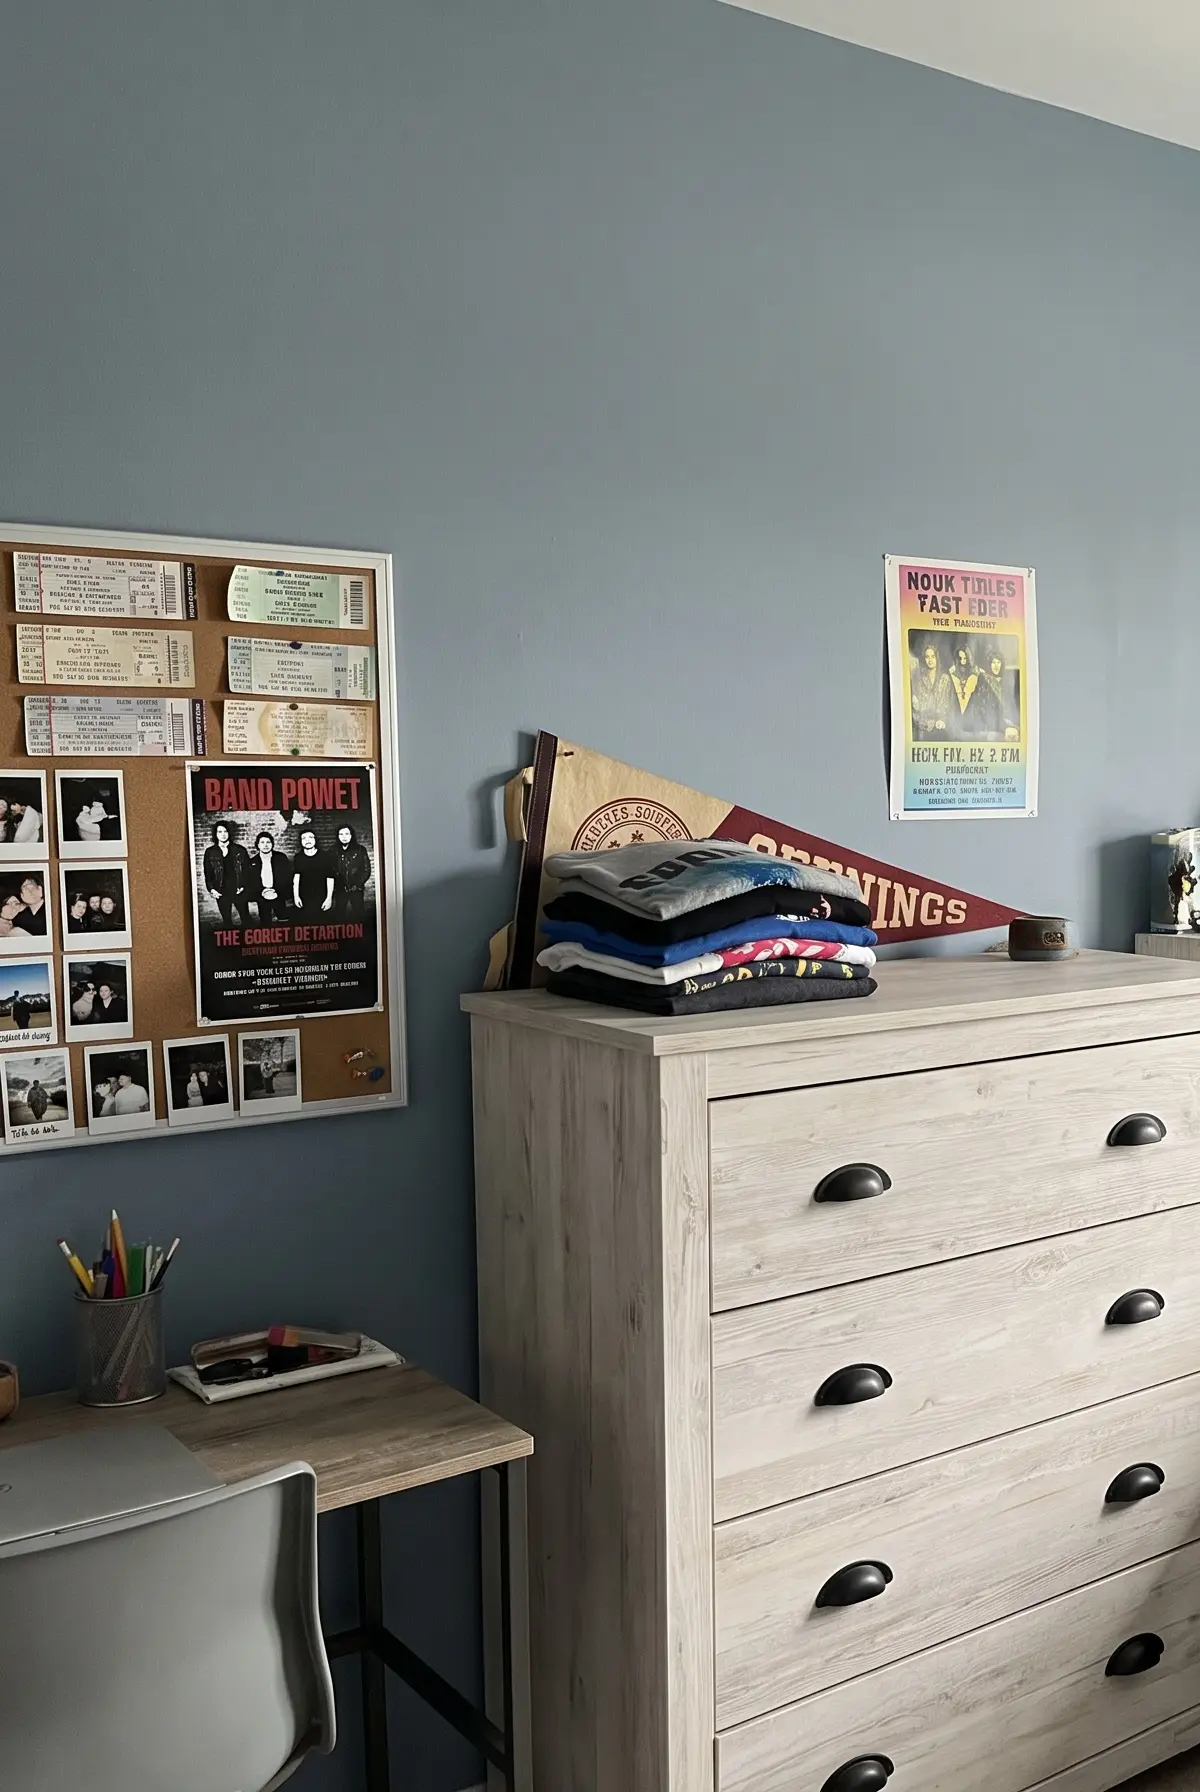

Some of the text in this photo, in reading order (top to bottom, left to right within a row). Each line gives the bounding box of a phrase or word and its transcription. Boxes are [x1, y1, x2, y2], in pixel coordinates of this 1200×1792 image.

[907, 571, 955, 593] NOUK
[204, 777, 361, 812] BAND POWET
[214, 929, 240, 947] THE
